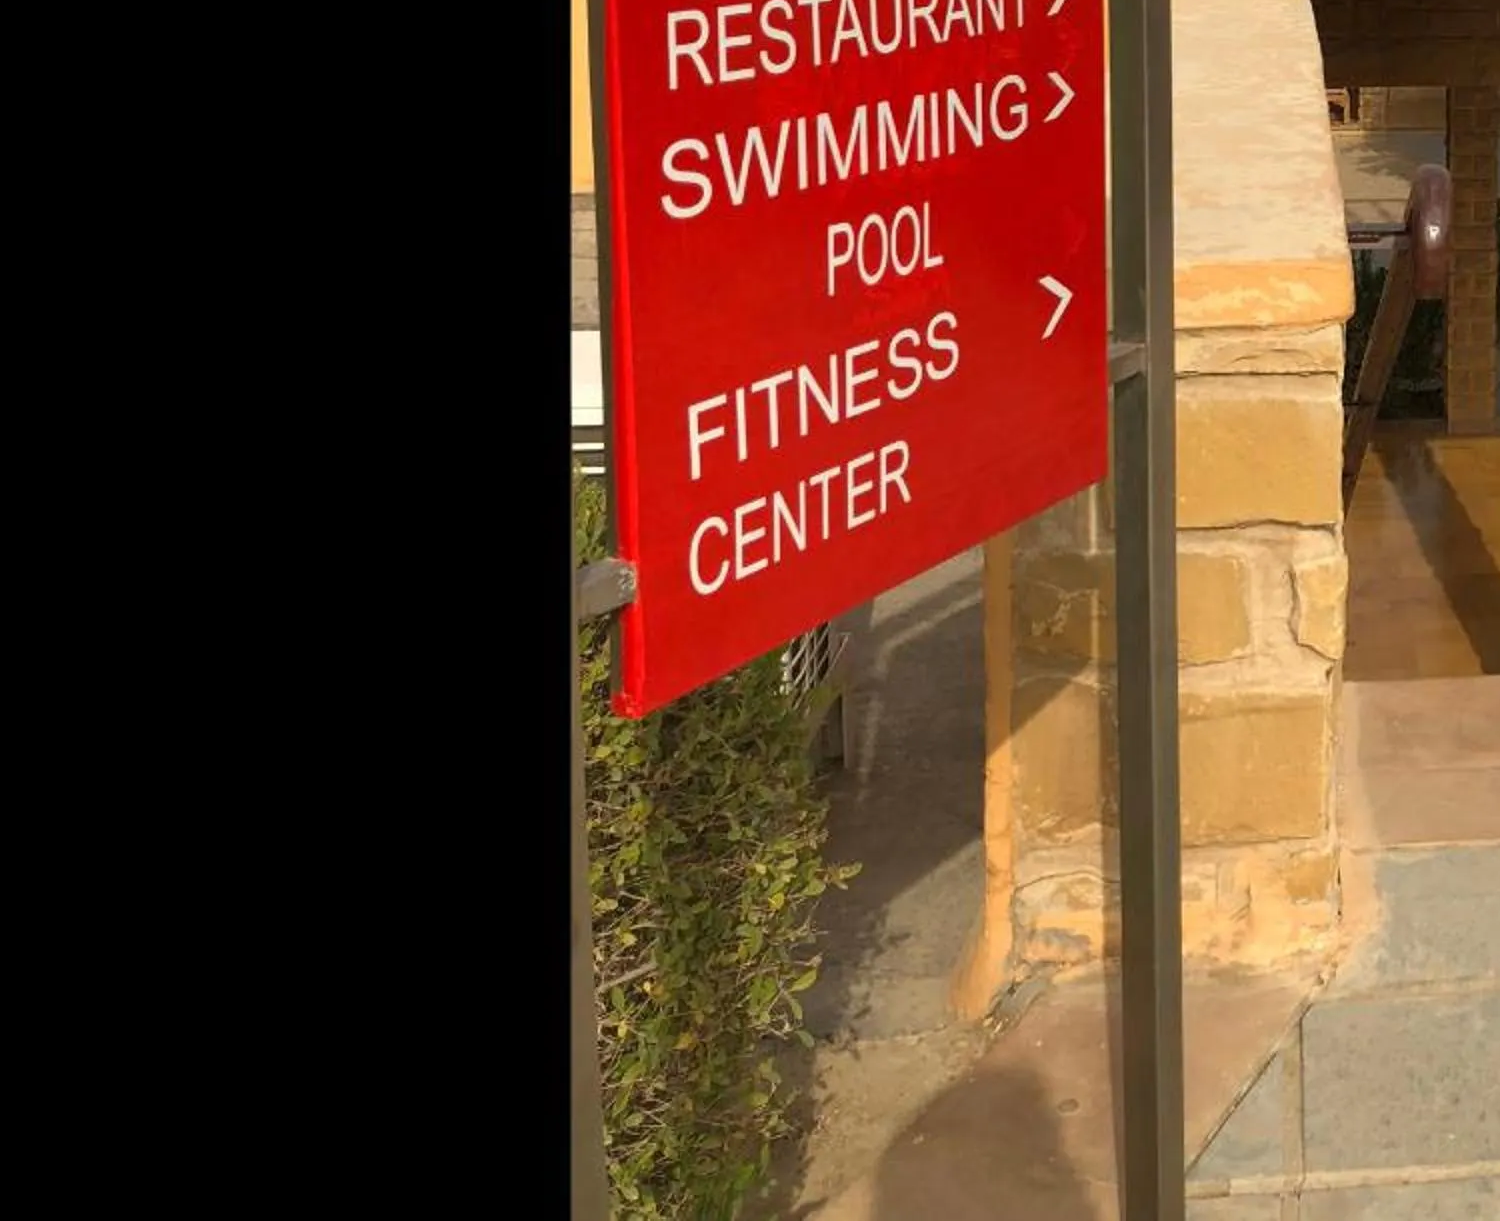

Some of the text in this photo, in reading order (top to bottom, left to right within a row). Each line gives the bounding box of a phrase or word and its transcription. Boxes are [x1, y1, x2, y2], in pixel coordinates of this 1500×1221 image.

[660, 73, 1029, 220] SWIMMING
[826, 201, 944, 297] POOL
[687, 310, 960, 481] FITNESS
[688, 439, 912, 596] CENTER
